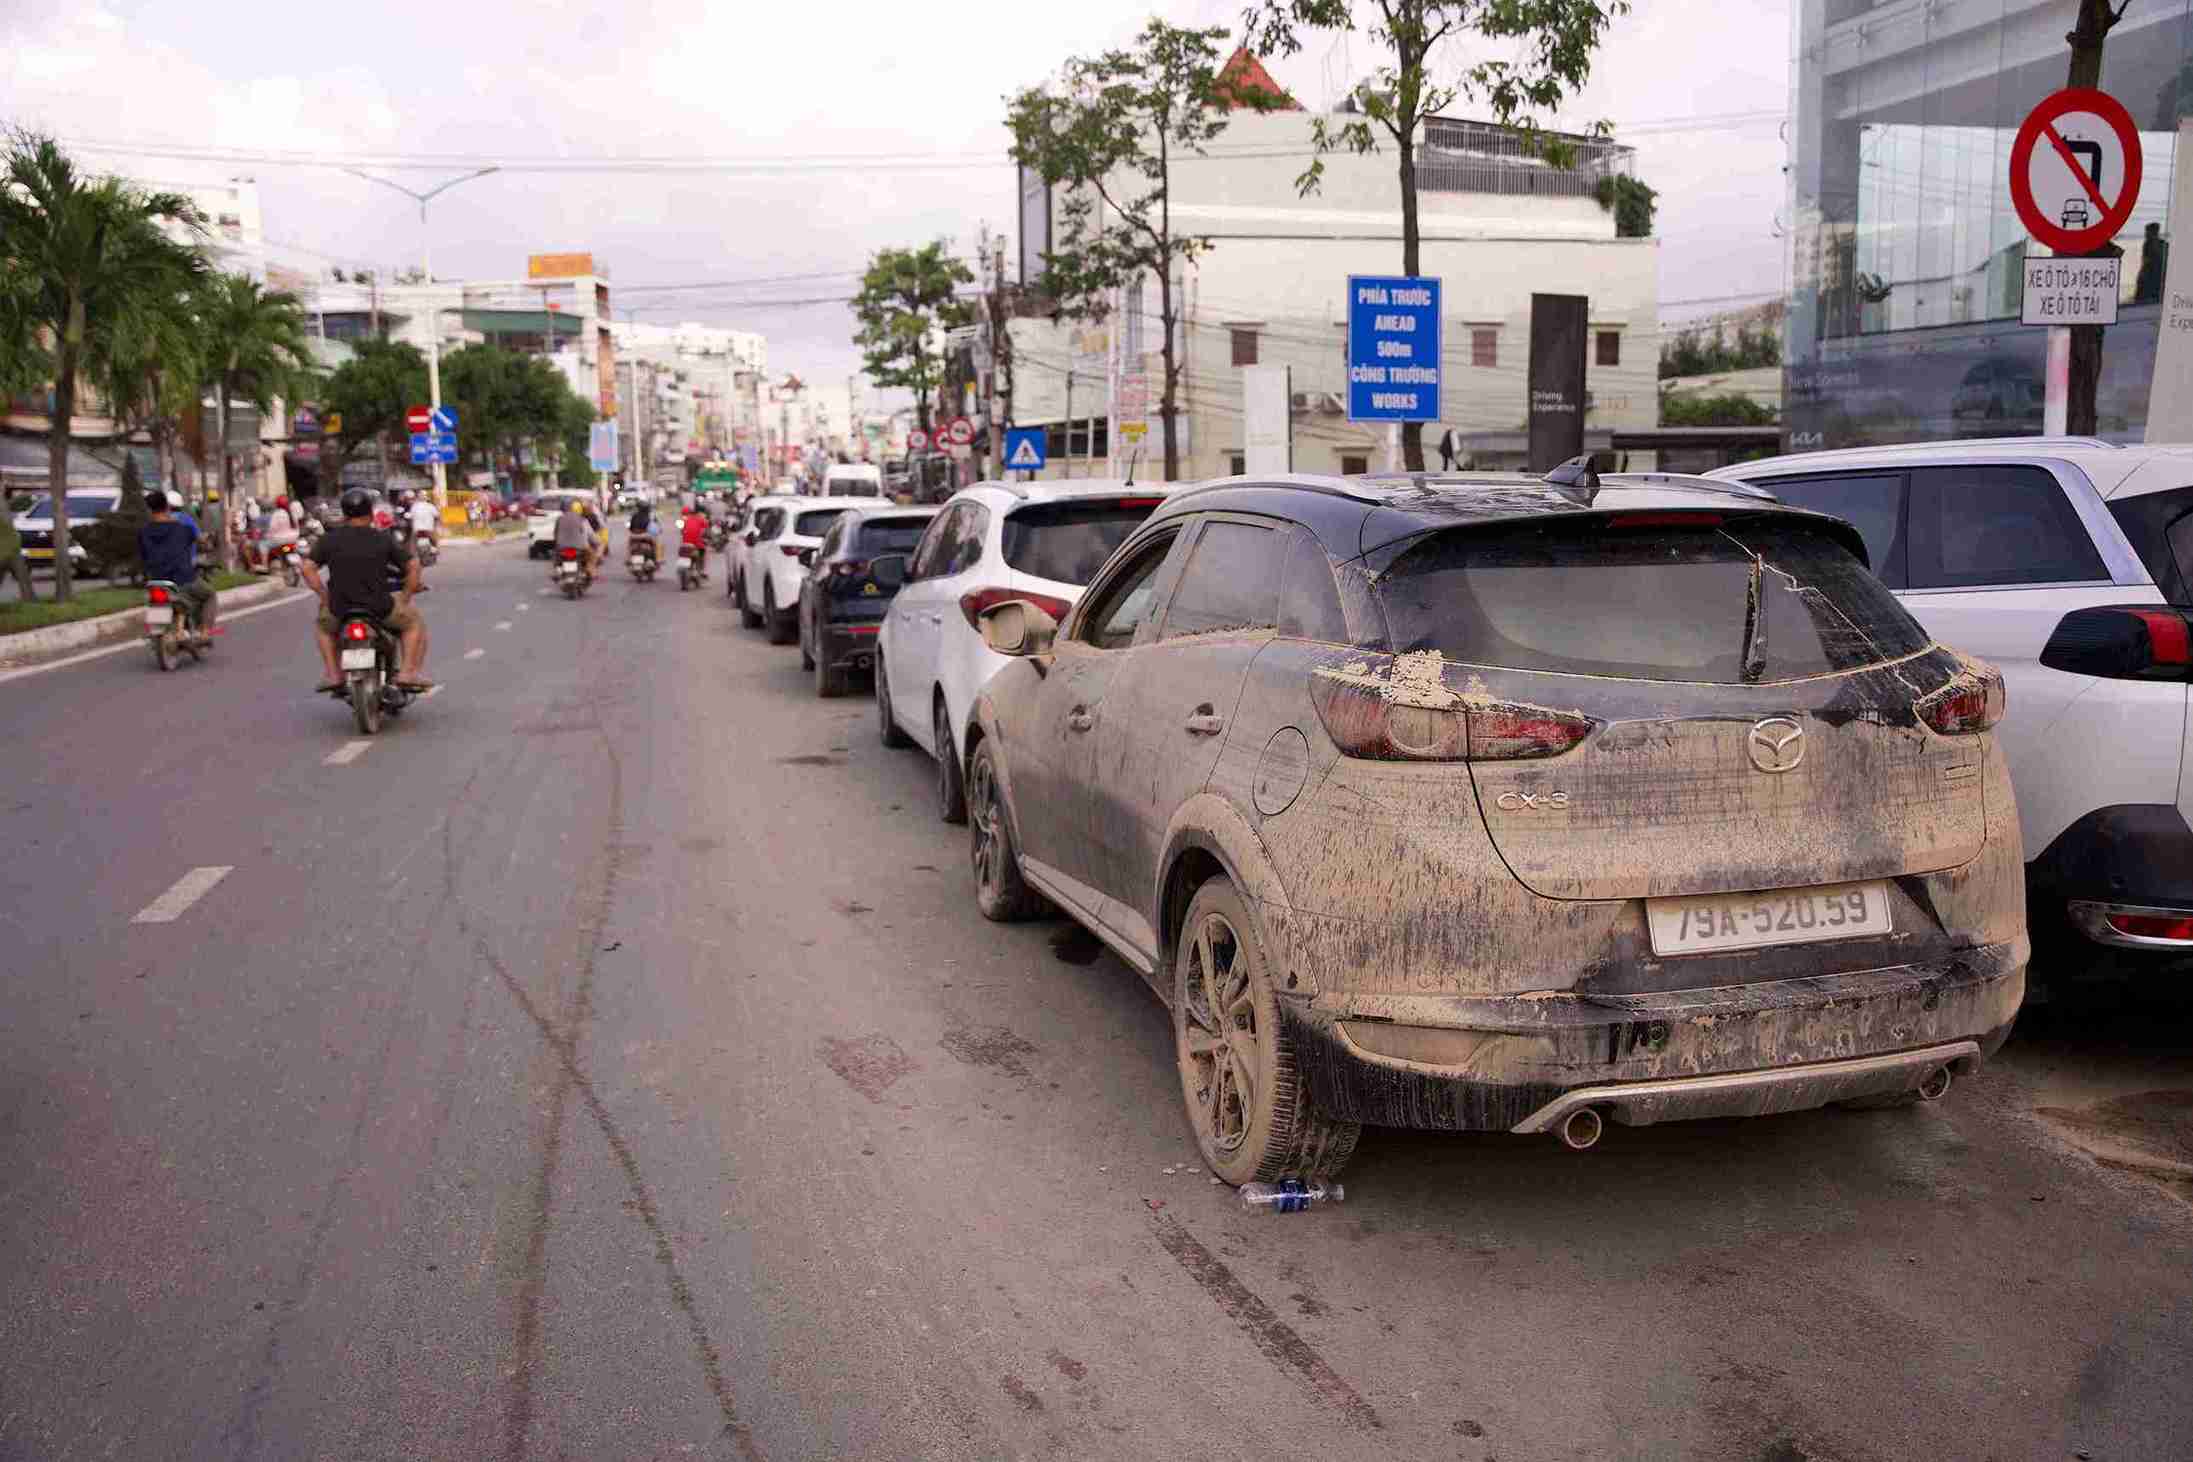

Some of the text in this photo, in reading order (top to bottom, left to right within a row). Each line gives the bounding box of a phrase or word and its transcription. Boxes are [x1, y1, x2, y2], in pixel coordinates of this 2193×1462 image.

[2028, 269, 2043, 288] XE
[2045, 265, 2054, 288] Ô
[2056, 265, 2070, 288] TÔ
[1358, 283, 1389, 305] PHÍA
[2040, 296, 2055, 315] XE
[2056, 291, 2065, 315] Ô
[2068, 291, 2081, 315] TÔ
[1374, 314, 1416, 332] AHEAD
[1376, 340, 1412, 357] 500m
[1351, 362, 1386, 383] CÔNG
[1371, 392, 1419, 410] WORKS
[1497, 791, 1569, 809] CX-3
